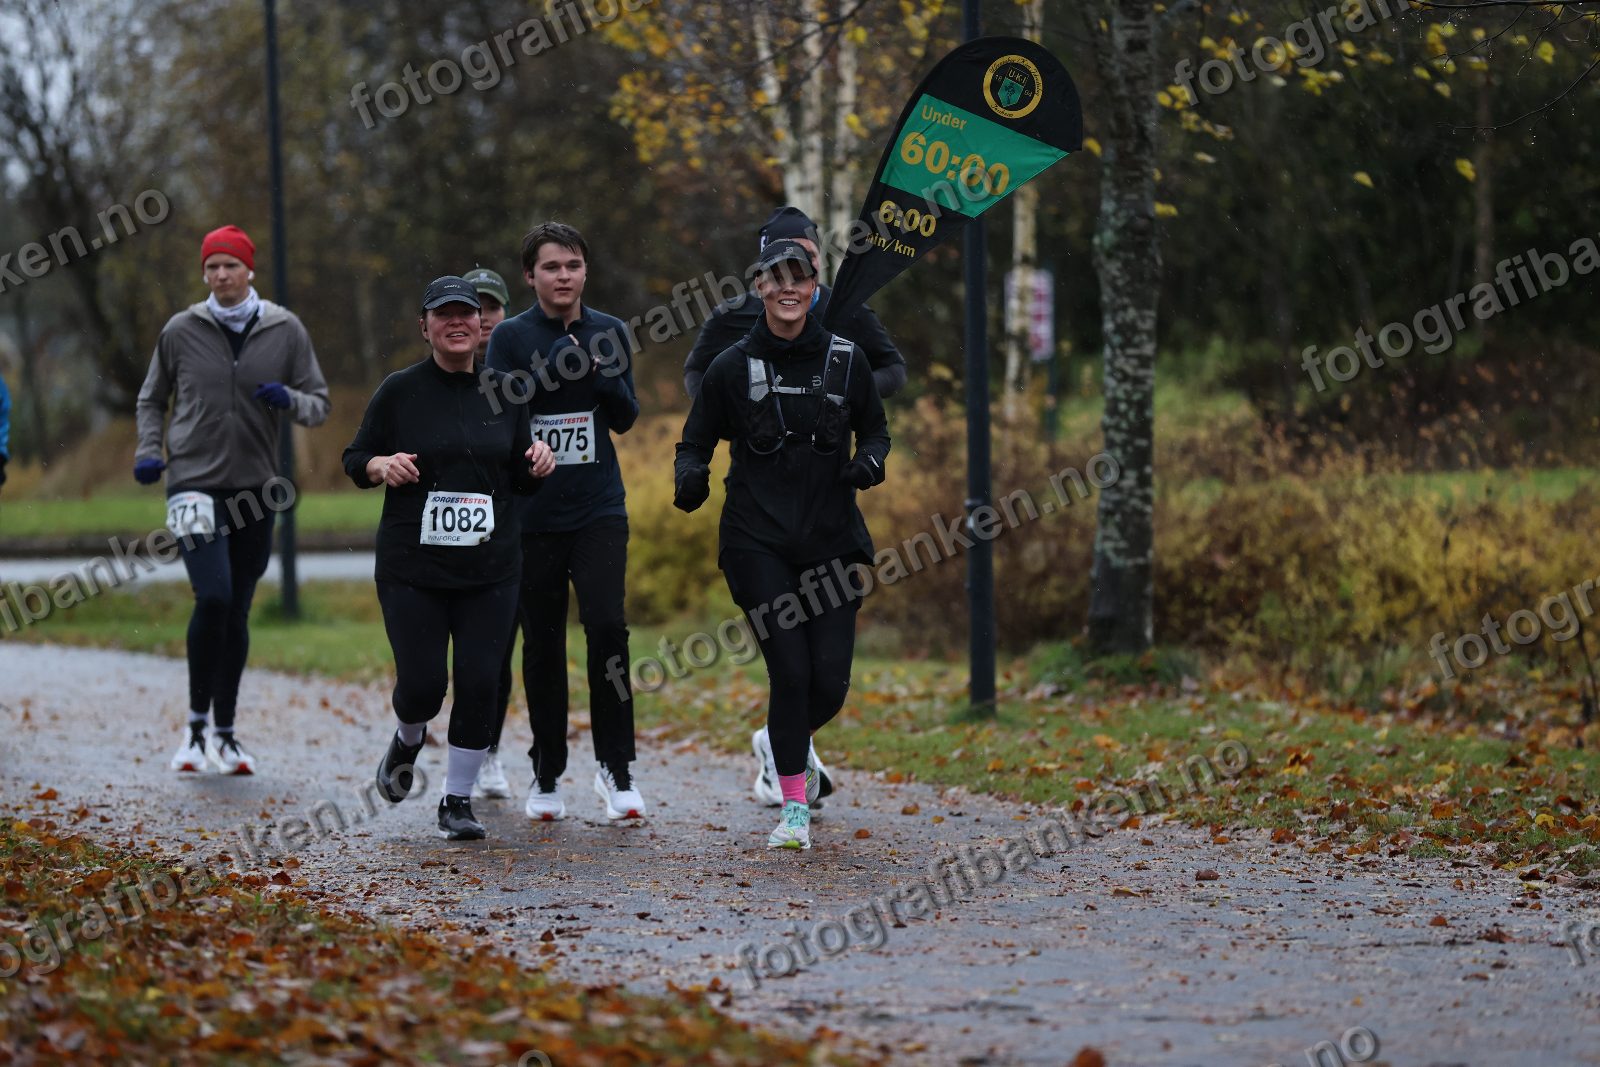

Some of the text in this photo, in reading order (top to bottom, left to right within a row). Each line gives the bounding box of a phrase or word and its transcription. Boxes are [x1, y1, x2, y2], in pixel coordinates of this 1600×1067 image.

[921, 105, 967, 129] Under
[901, 132, 1010, 195] 60:00
[879, 200, 937, 237] 6:00
[866, 231, 916, 257] min/km
[534, 416, 589, 426] NORGESTESTEN
[534, 427, 589, 453] 1075
[430, 506, 487, 533] 1082
